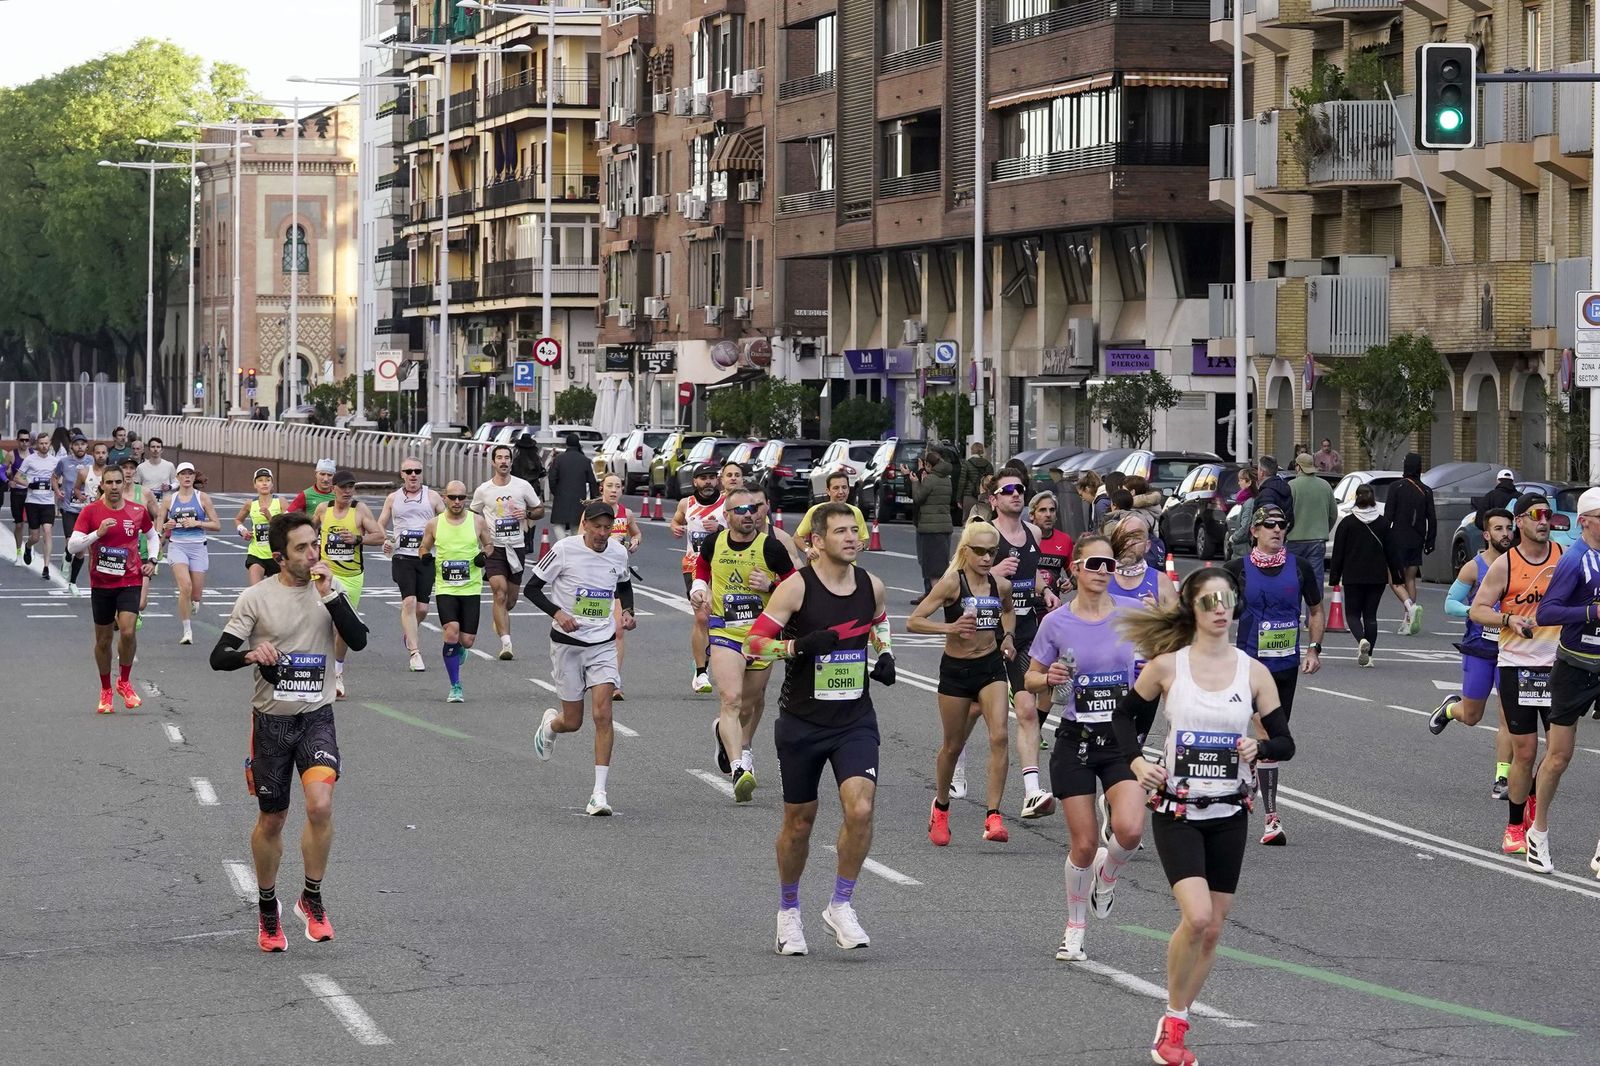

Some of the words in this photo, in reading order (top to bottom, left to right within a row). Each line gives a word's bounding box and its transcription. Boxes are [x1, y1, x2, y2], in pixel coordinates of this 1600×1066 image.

[641, 352, 672, 360] TINTE
[648, 360, 668, 373] 5€
[1581, 363, 1595, 371] ZONA
[517, 365, 530, 380] P
[1578, 374, 1599, 382] SECTOR
[590, 589, 610, 597] ZURICH
[582, 607, 603, 616] KEBIR
[736, 611, 754, 619] TANI
[294, 655, 323, 664] ZURICH
[834, 653, 861, 661] ZURICH
[827, 677, 855, 688] OSHRI
[1092, 674, 1122, 683] ZURICH
[1094, 689, 1111, 698] 5263
[1519, 690, 1541, 698] MIGUEL
[1087, 699, 1117, 711] YENTI
[1199, 735, 1235, 744] ZURICH
[1199, 752, 1218, 762] 5272
[1188, 764, 1227, 777] TUNDE
